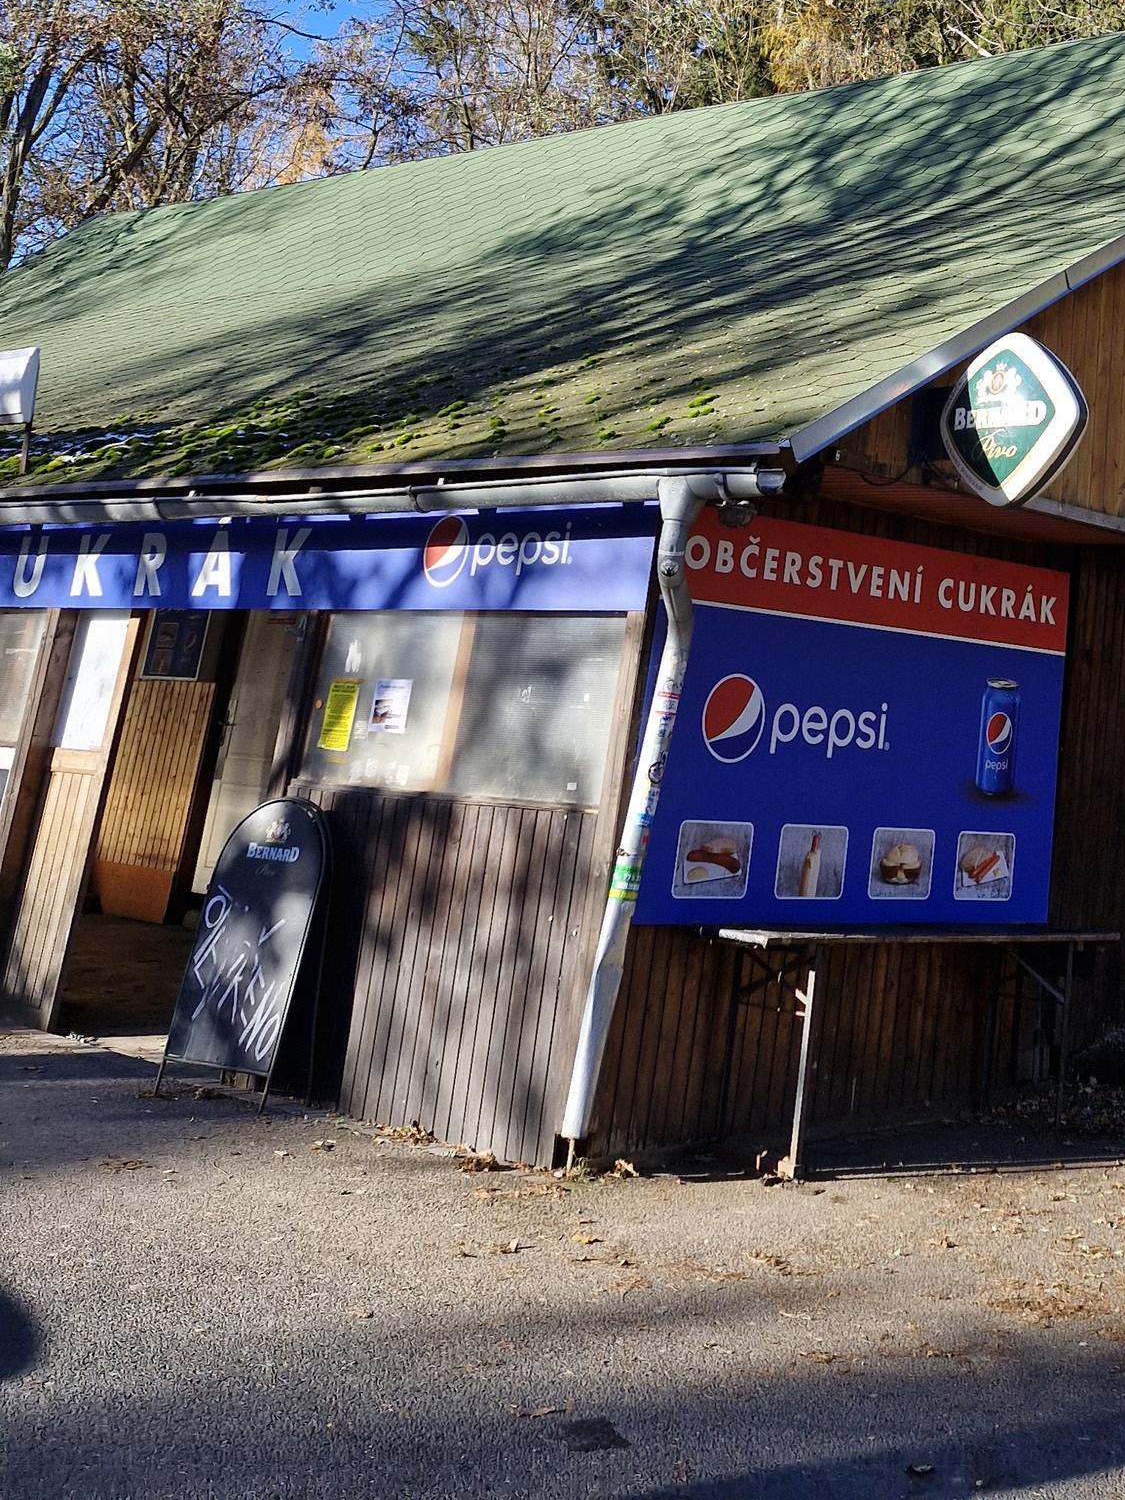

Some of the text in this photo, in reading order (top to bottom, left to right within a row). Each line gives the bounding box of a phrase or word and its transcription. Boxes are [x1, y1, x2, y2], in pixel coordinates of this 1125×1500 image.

[954, 399, 1047, 430] BERND
[971, 427, 1018, 460] Pivo
[470, 521, 572, 577] pepsi
[685, 535, 1057, 626] OBČERSTVENÍ CUKRÁK
[769, 702, 888, 759] pepsi
[985, 759, 1008, 772] pepsi
[246, 842, 300, 863] BERNARD
